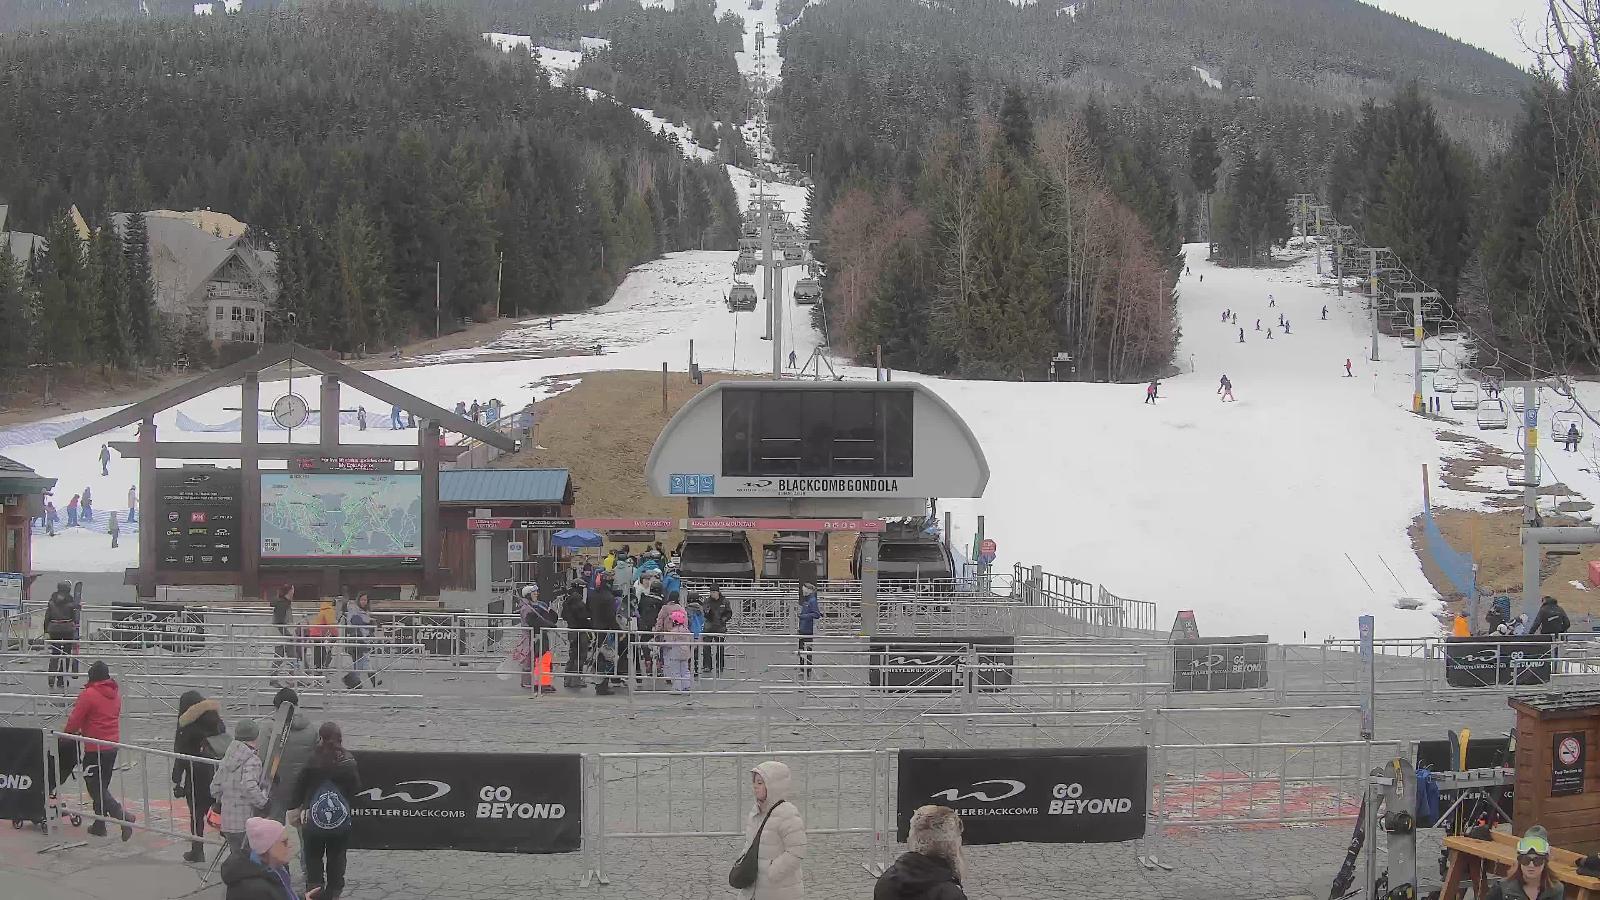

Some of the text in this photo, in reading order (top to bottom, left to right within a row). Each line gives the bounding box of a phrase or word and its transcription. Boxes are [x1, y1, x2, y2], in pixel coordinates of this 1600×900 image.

[778, 479, 898, 491] BLACKCOMB GONDOLA
[1233, 655, 1245, 664] GO
[1511, 651, 1524, 659] GO
[479, 785, 511, 801] GO
[1052, 783, 1083, 798] GO
[476, 802, 566, 819] BEYOND
[1048, 798, 1131, 814] BEYOND
[350, 808, 466, 818] HISTLERBLACKCOMB
